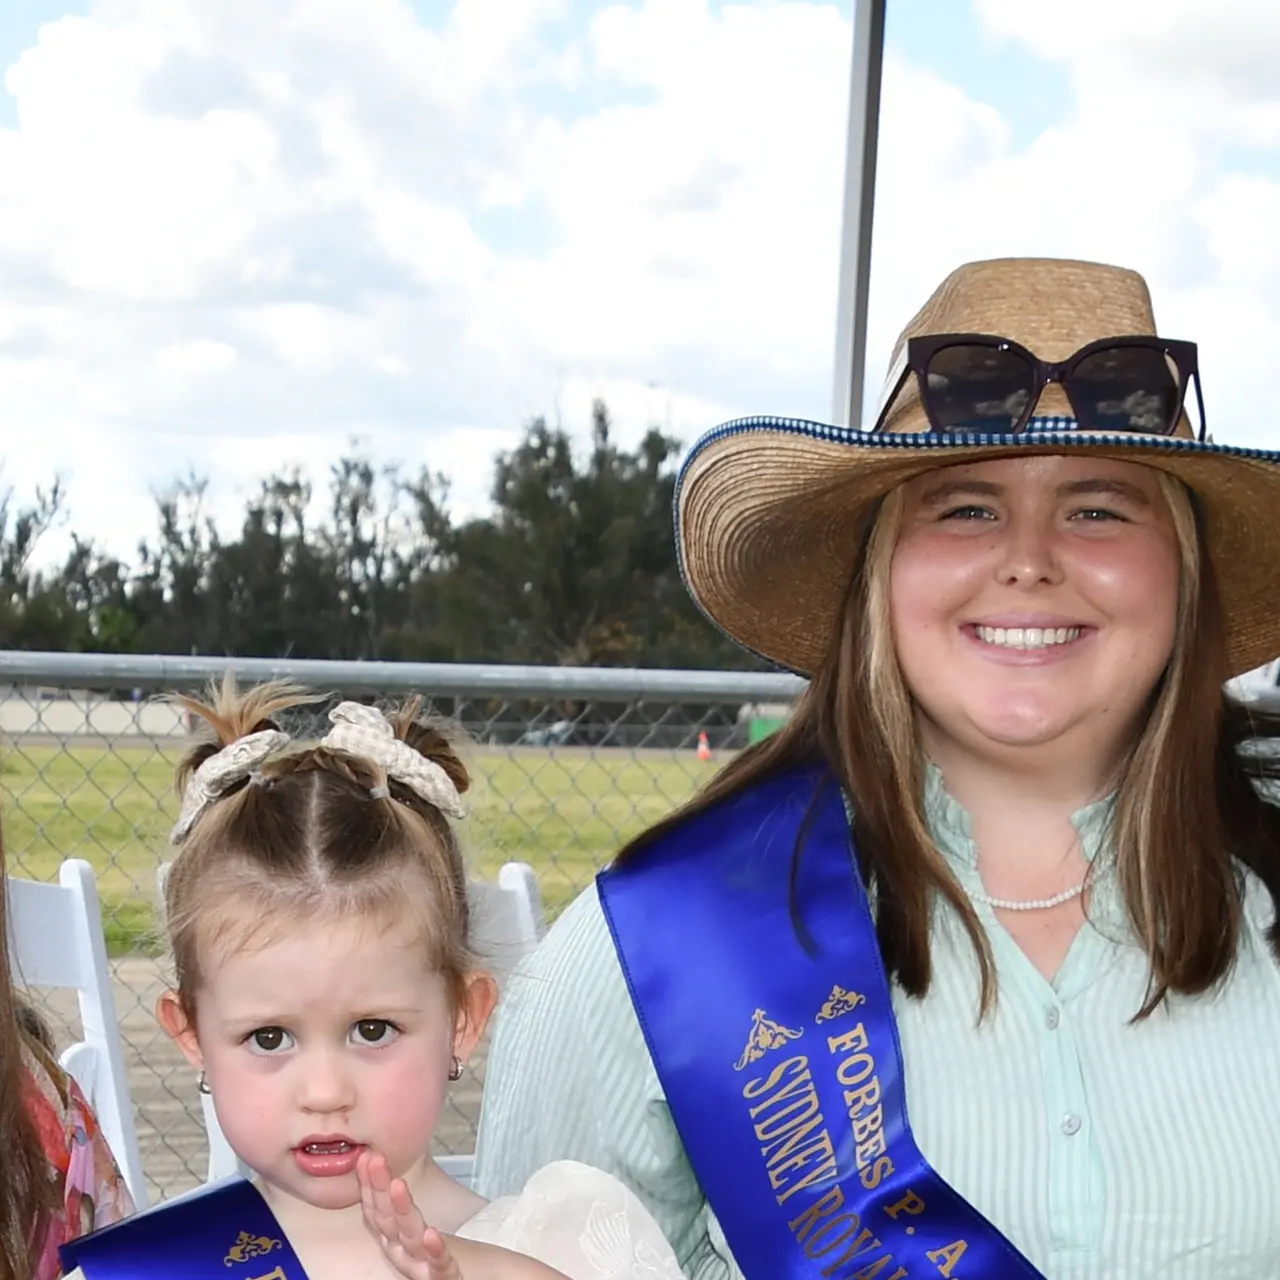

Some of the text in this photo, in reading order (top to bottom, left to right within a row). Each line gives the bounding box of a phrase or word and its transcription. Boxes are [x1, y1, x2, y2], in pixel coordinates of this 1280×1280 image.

[742, 1055, 840, 1206] SYDNEY
[827, 1021, 895, 1190] FORBES
[883, 1189, 927, 1236] P.
